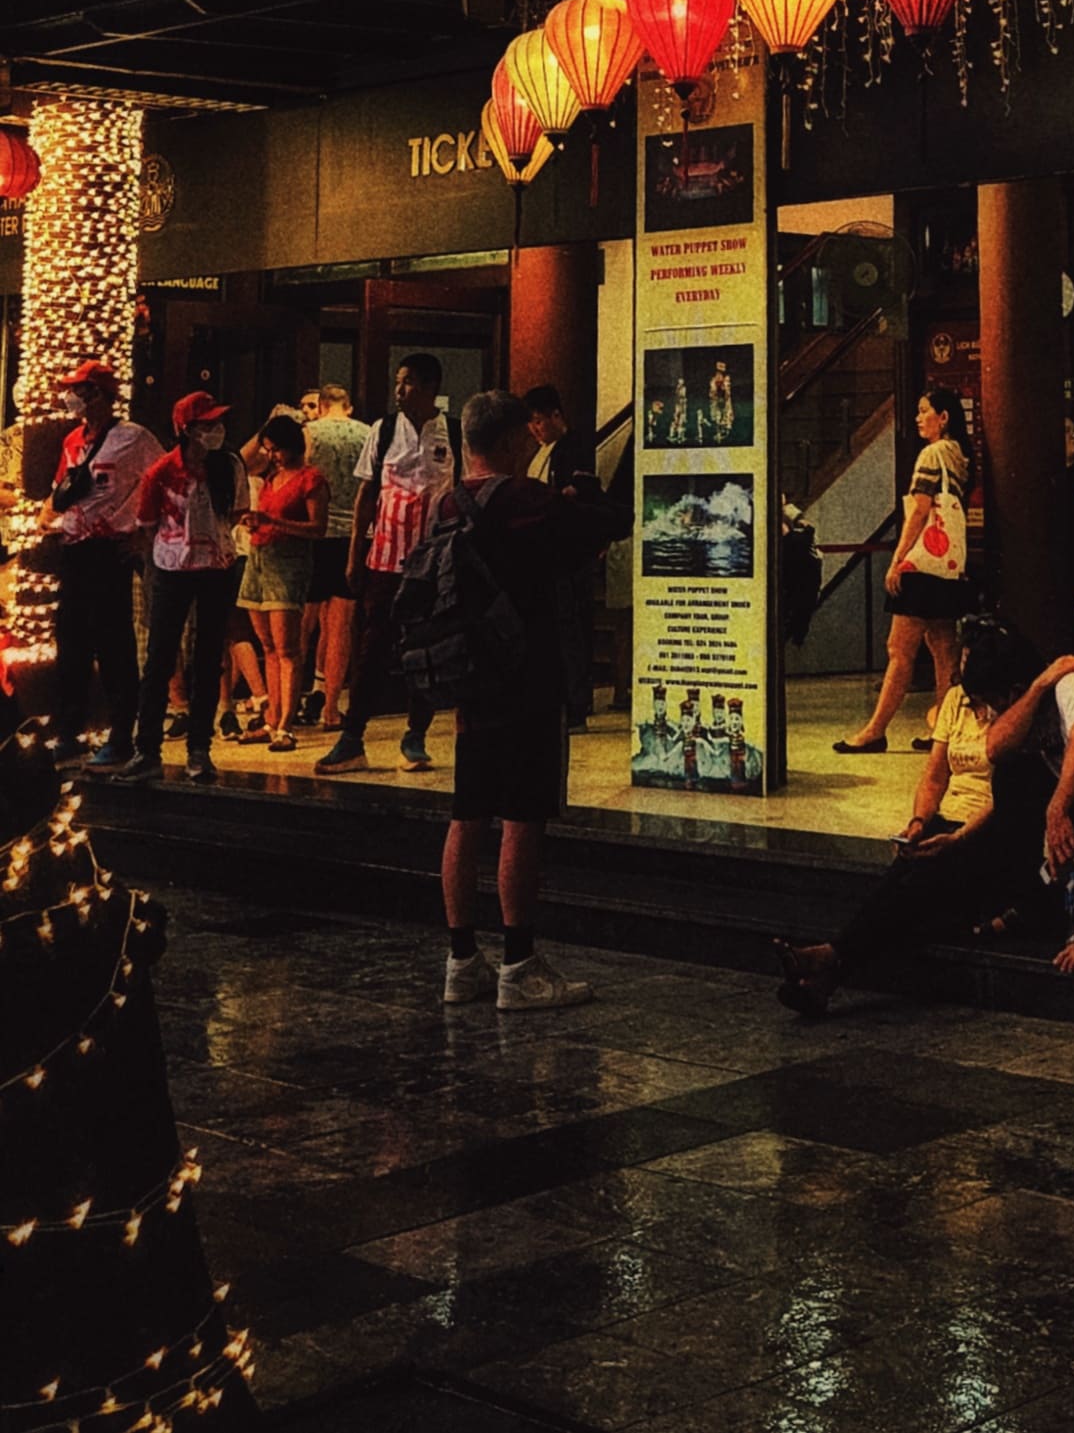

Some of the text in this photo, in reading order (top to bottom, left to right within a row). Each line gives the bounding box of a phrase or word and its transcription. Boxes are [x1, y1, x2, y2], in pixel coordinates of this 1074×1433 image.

[407, 130, 493, 178] TICKE
[650, 237, 747, 257] WATER PUPPET SHOW
[650, 262, 746, 281] PERFORMING WEEKLY
[675, 288, 720, 303] EVERYDAY
